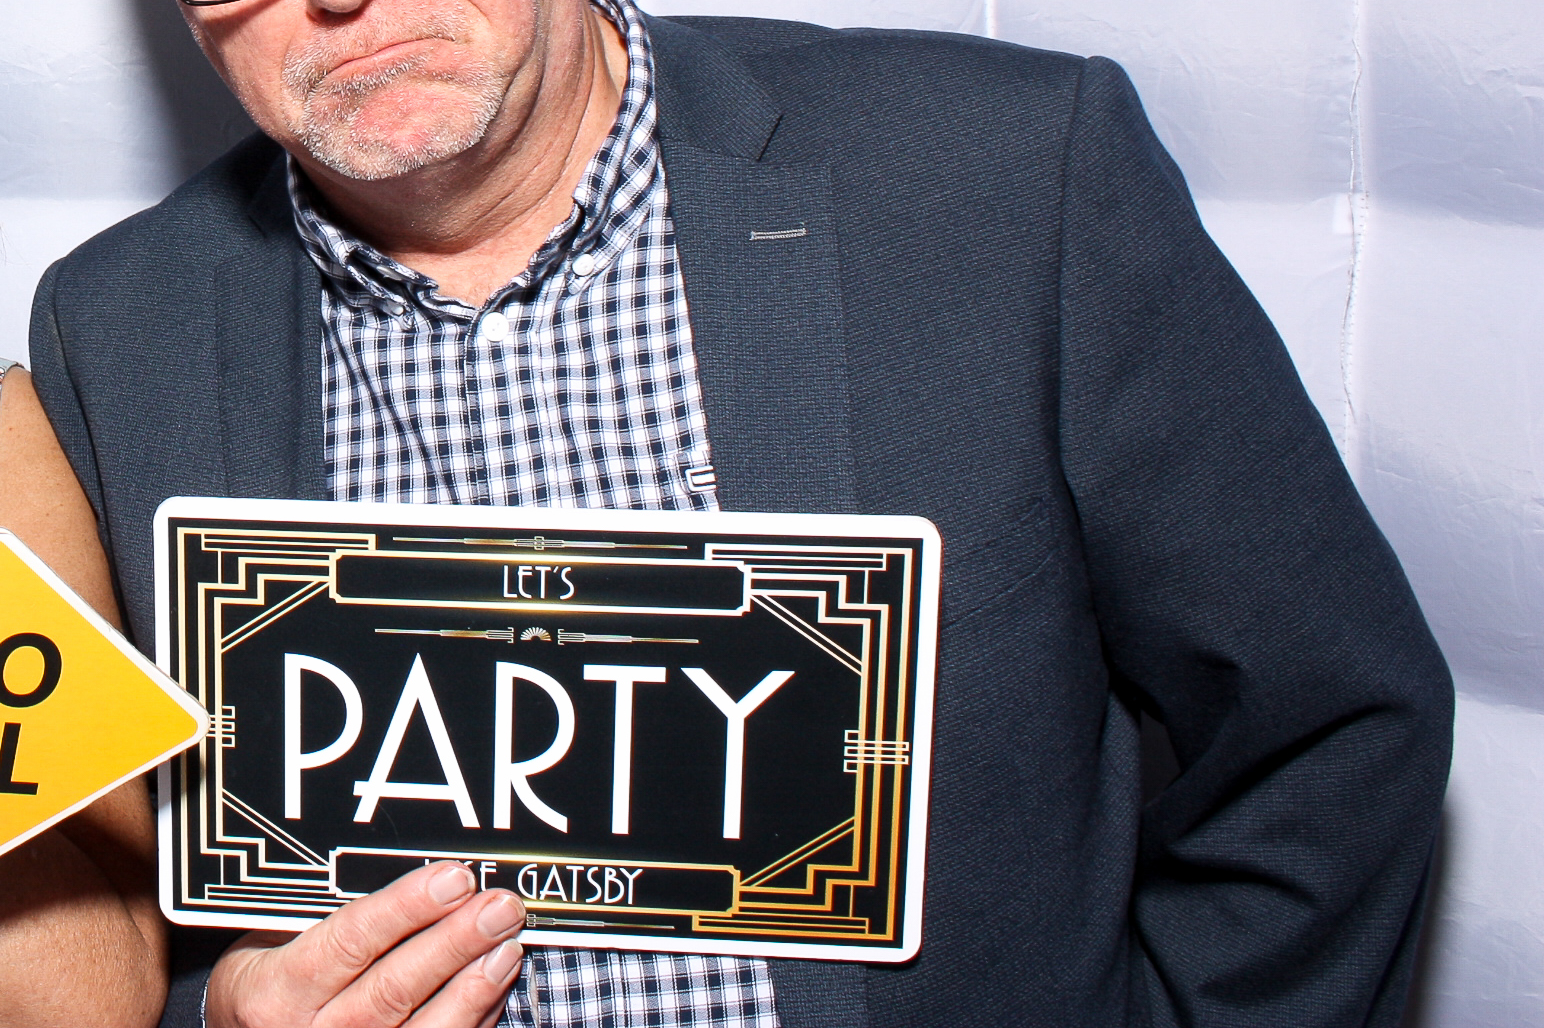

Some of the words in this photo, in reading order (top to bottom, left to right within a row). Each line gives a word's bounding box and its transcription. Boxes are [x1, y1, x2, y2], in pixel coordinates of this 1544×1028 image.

[502, 564, 575, 600] LET'S
[283, 652, 796, 840] PARTY
[517, 863, 644, 905] GATSBY
